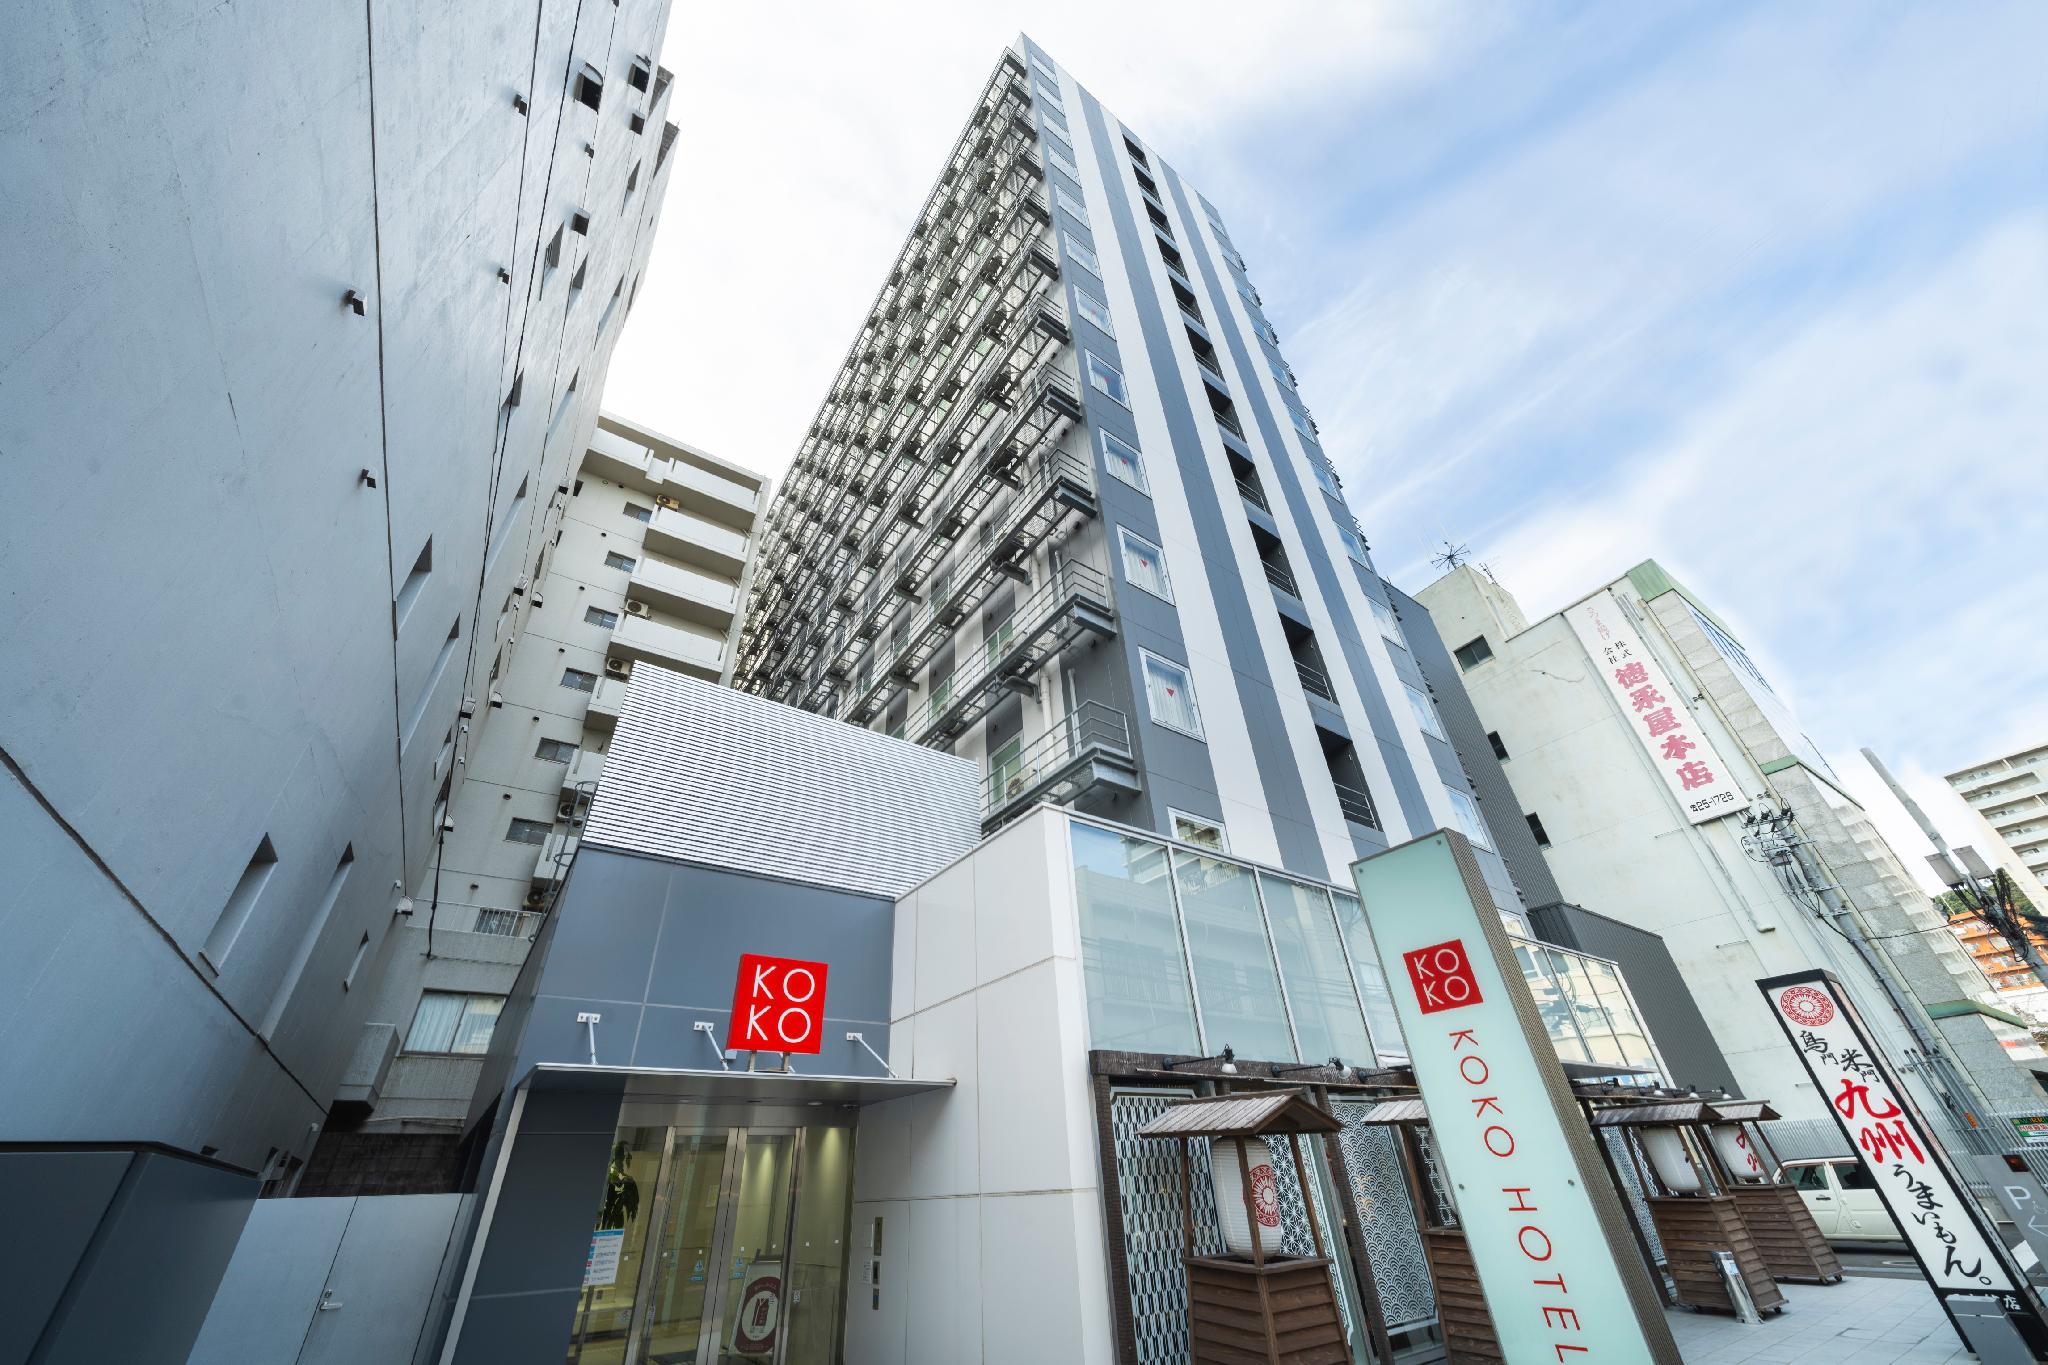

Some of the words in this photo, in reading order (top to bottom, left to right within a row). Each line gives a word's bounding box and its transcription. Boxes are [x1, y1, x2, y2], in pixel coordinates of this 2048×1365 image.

[1413, 948, 1460, 979] KO
[751, 963, 815, 1003] KO
[1422, 975, 1470, 1006] KO
[746, 1003, 811, 1043] KO
[1449, 1029, 1515, 1157] KOKO
[1502, 1187, 1589, 1363] HOTEL
[2003, 1186, 2032, 1210] P
